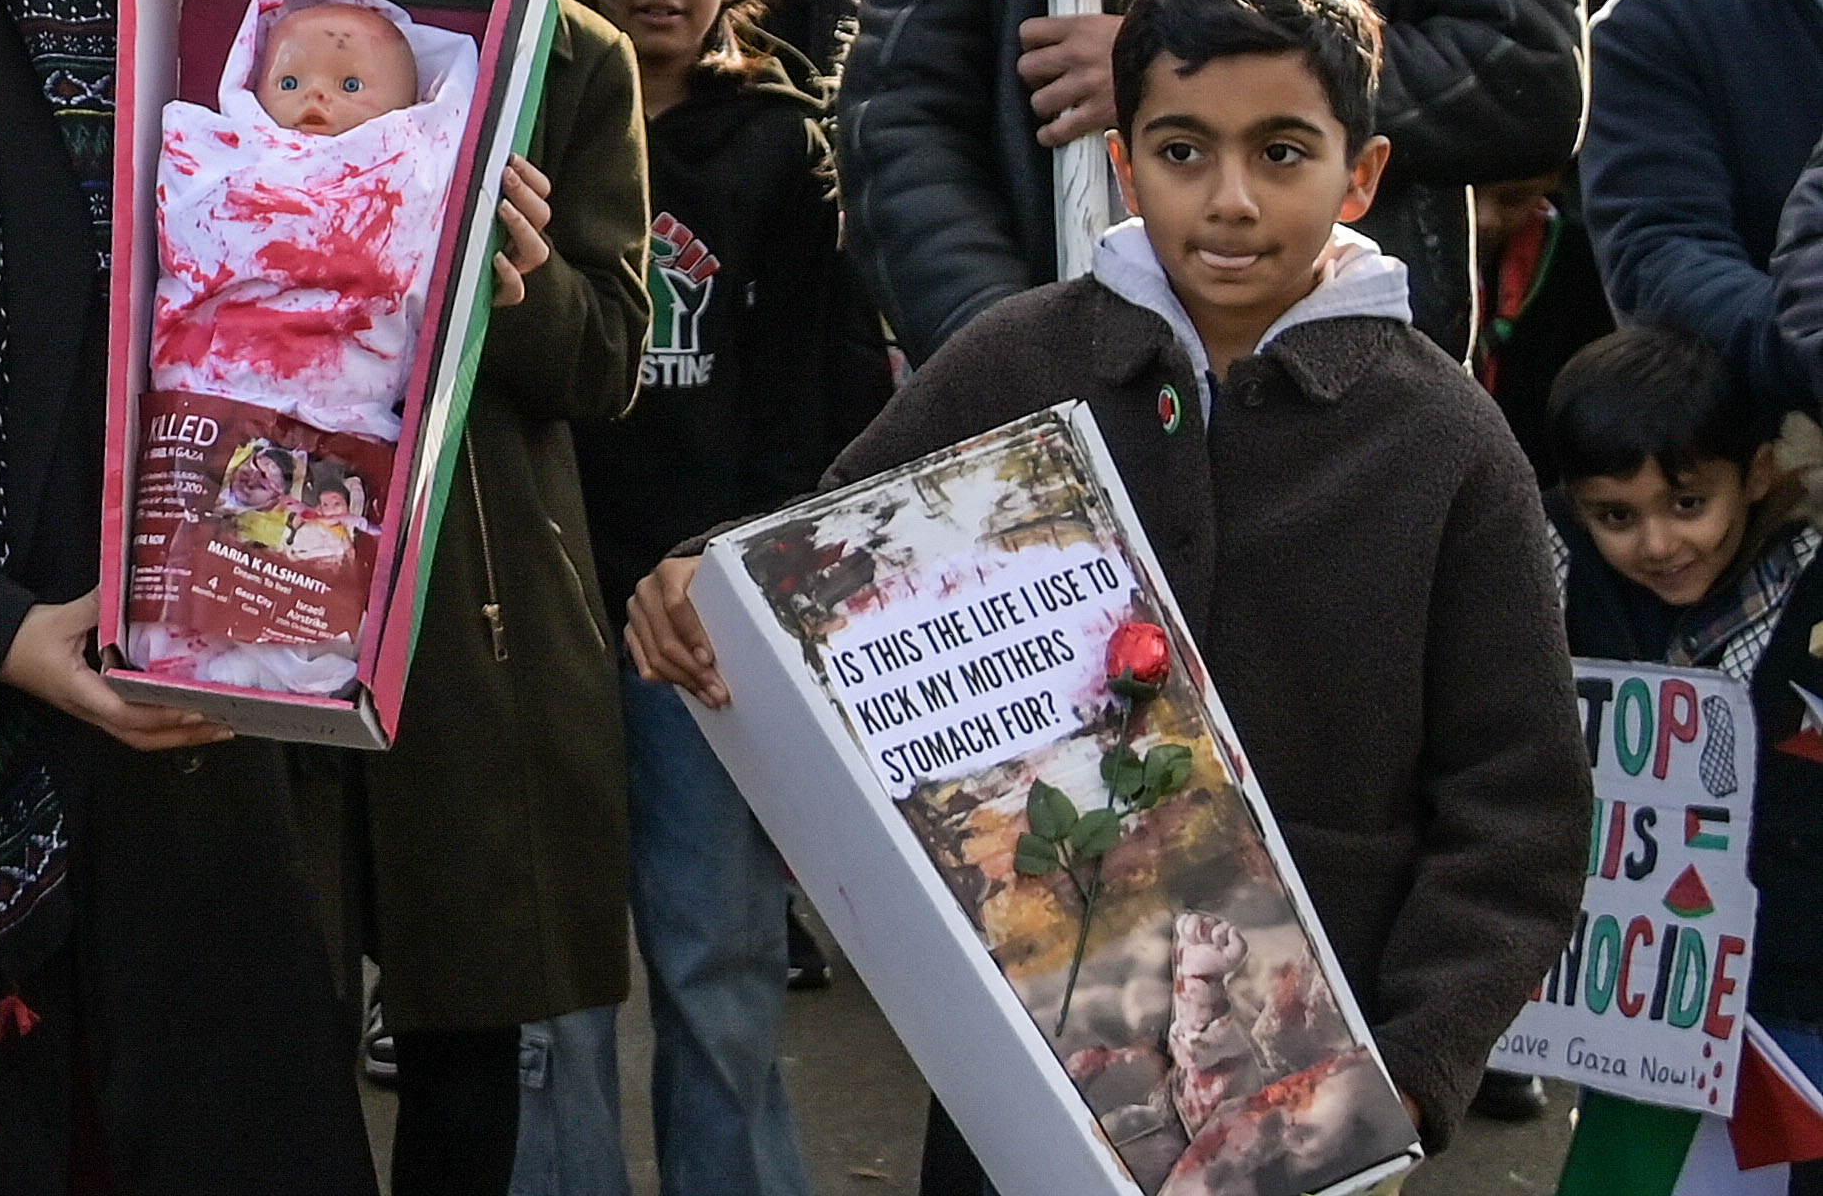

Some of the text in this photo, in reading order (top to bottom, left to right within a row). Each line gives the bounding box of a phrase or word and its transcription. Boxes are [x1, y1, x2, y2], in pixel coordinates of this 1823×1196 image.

[207, 540, 326, 594] MARIA K ALSHANTI
[208, 576, 219, 590] 4
[832, 557, 1119, 688] IS THIS THE LIFE I USE TO
[855, 629, 1075, 736] KICK MY MOTHERS
[1576, 677, 1699, 780] TOP
[881, 690, 1061, 784] STOMACH FOR?
[1531, 911, 1745, 1039] NOCIDE
[1567, 1037, 1626, 1075] Gaza
[1641, 1057, 1696, 1088] Now!
